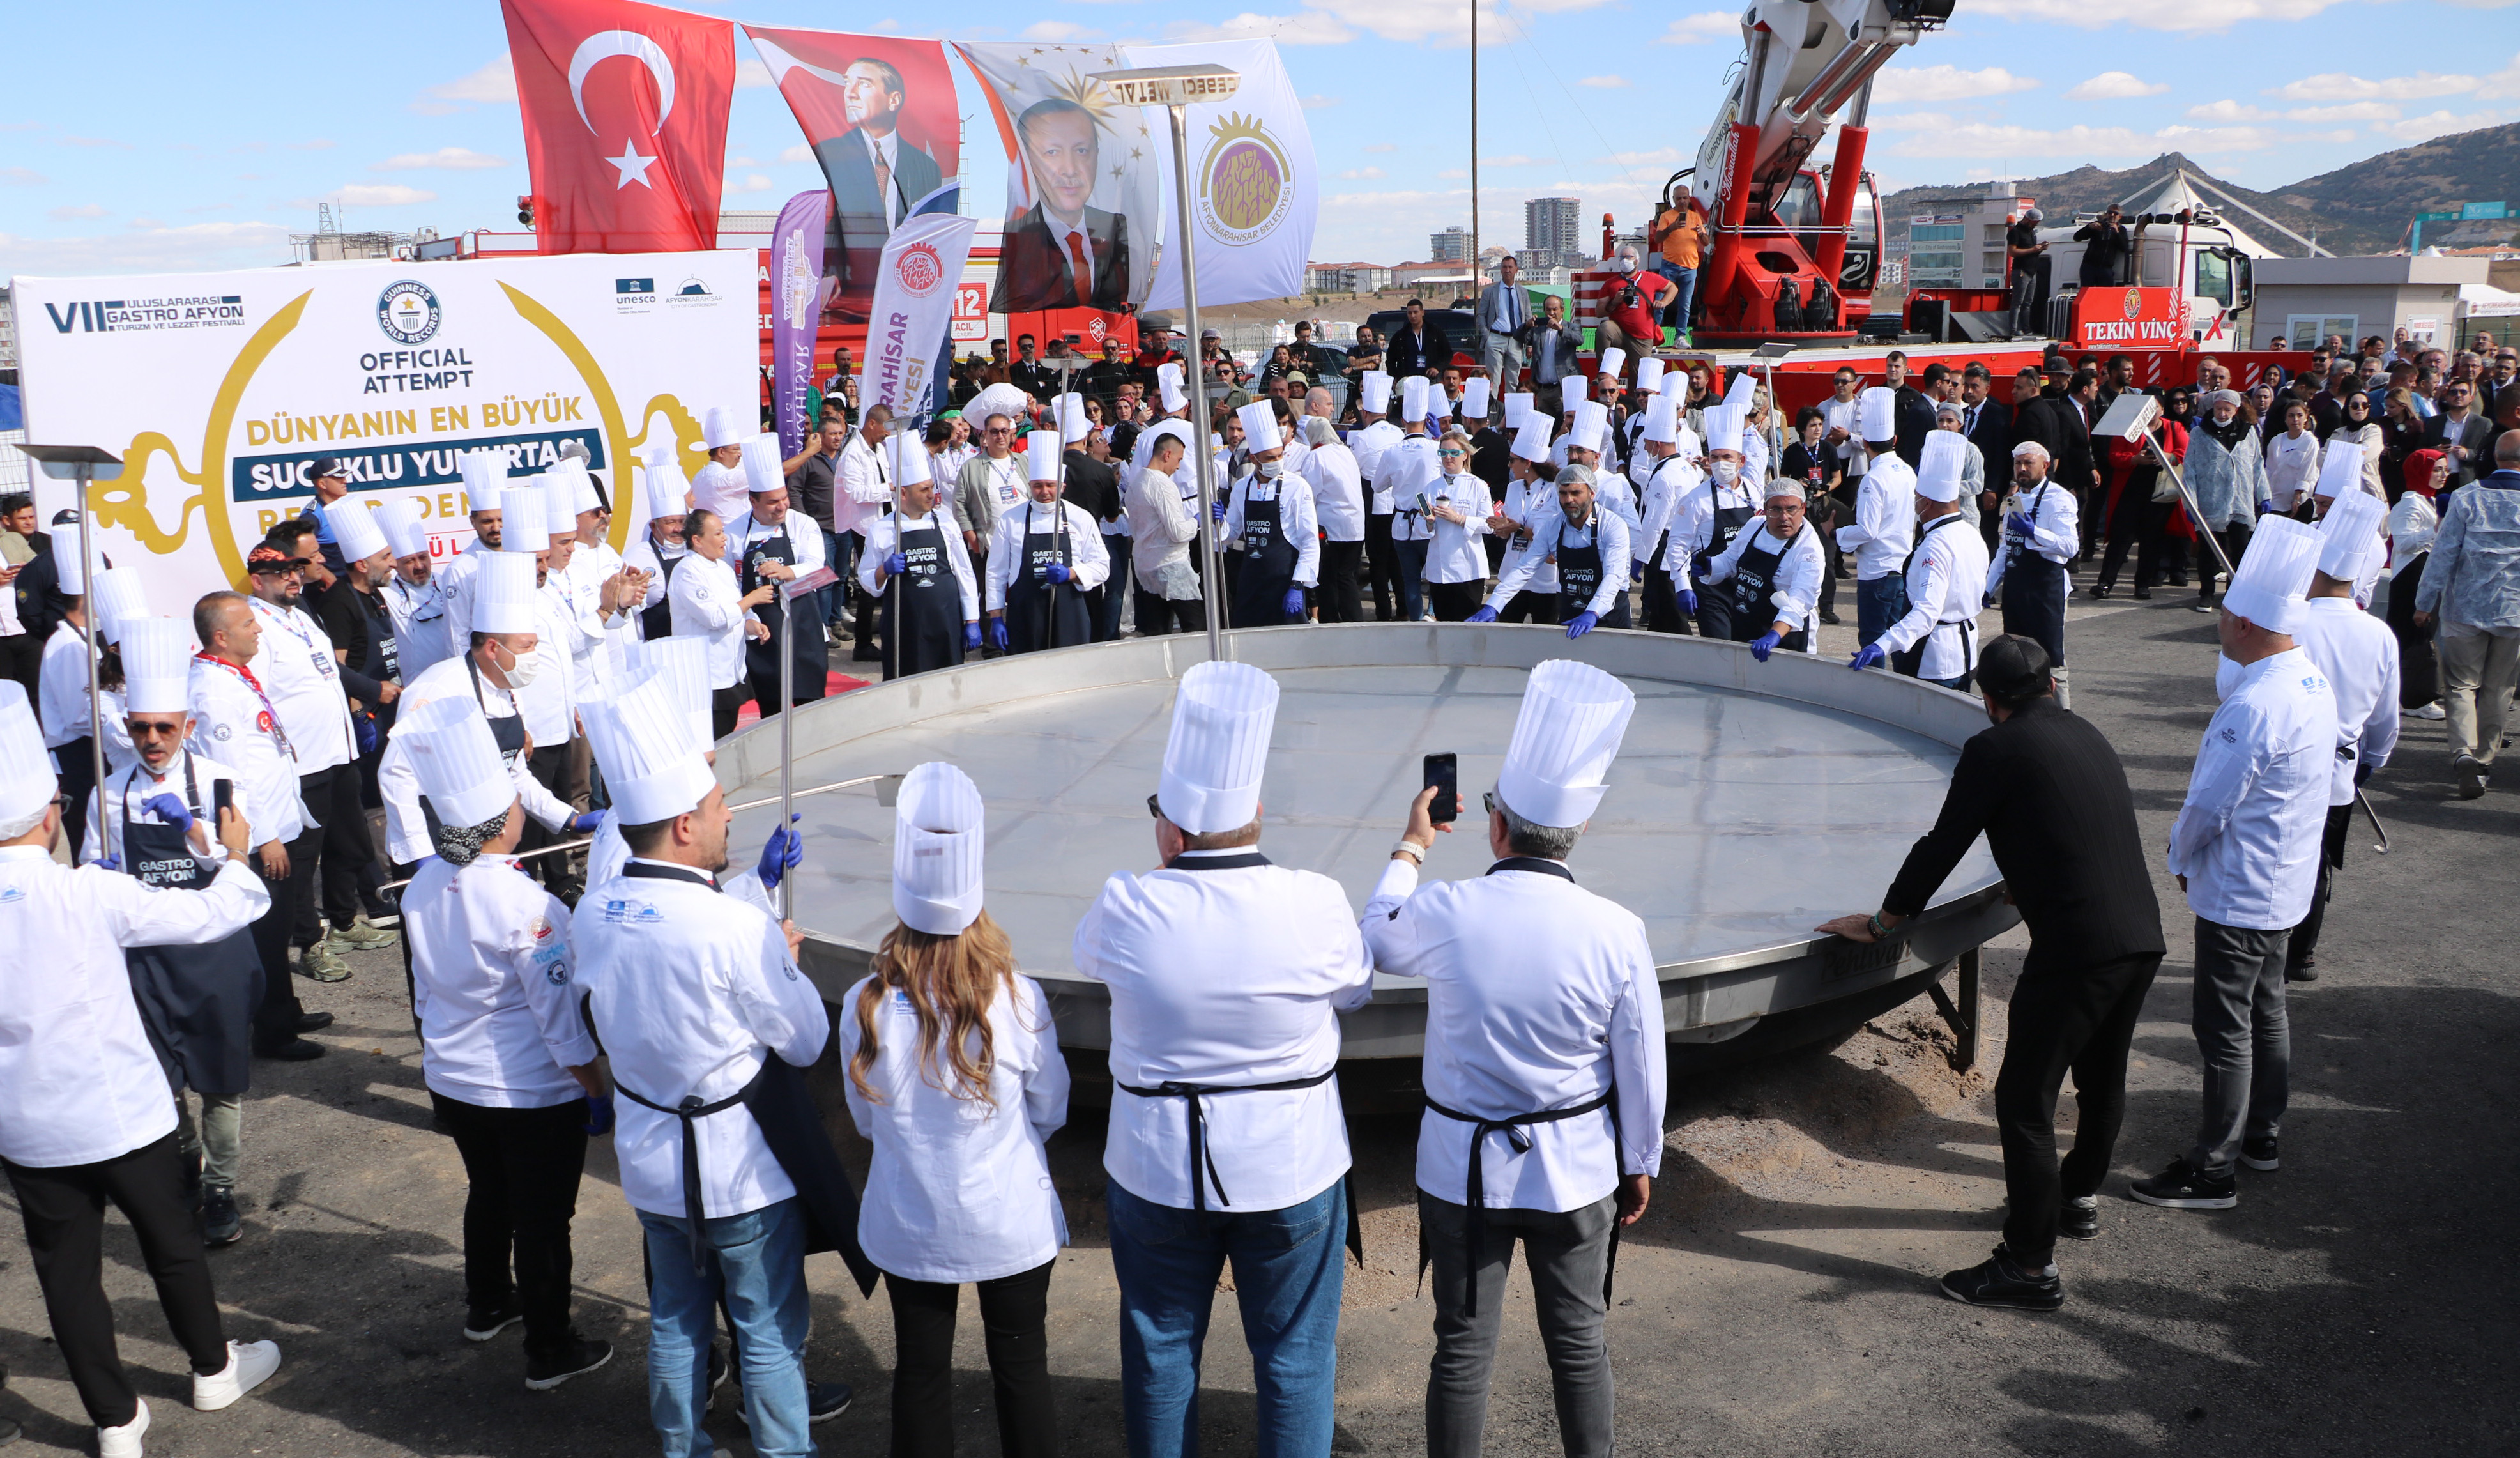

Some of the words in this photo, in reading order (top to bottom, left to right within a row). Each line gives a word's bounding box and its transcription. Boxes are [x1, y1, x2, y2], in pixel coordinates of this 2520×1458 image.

[1115, 80, 1170, 104] METAL
[1201, 201, 1258, 242] AFYONKARAHİSAR
[1260, 187, 1291, 234] BELEDİYESİ
[128, 296, 221, 309] ULUSLARARASI
[384, 283, 432, 303] GUINNESS
[616, 296, 656, 304] unesco
[105, 309, 179, 323] GASTRO
[185, 305, 245, 319] AFYON
[380, 310, 405, 341] WORLD
[408, 307, 439, 342] RECORDS
[2084, 318, 2136, 341] TEKİN
[2140, 318, 2177, 342] VİNÇ
[360, 348, 473, 372] OFFICIAL
[880, 312, 908, 411] RAHİSAR
[363, 370, 474, 394] ATTEMPT
[897, 357, 926, 412] İYESİ
[246, 410, 418, 446] DÜNYANIN
[430, 404, 470, 432] EN
[482, 392, 583, 428] BÜYÜK
[251, 452, 404, 491] SUCKLU
[905, 547, 937, 556] GASTRO
[906, 553, 938, 564] AFYON
[1565, 574, 1594, 582] AFYON
[1737, 572, 1764, 588] AFYON
[382, 644, 397, 657] AFYO
[139, 858, 195, 871] GASTRO
[142, 869, 197, 884] AFYON
